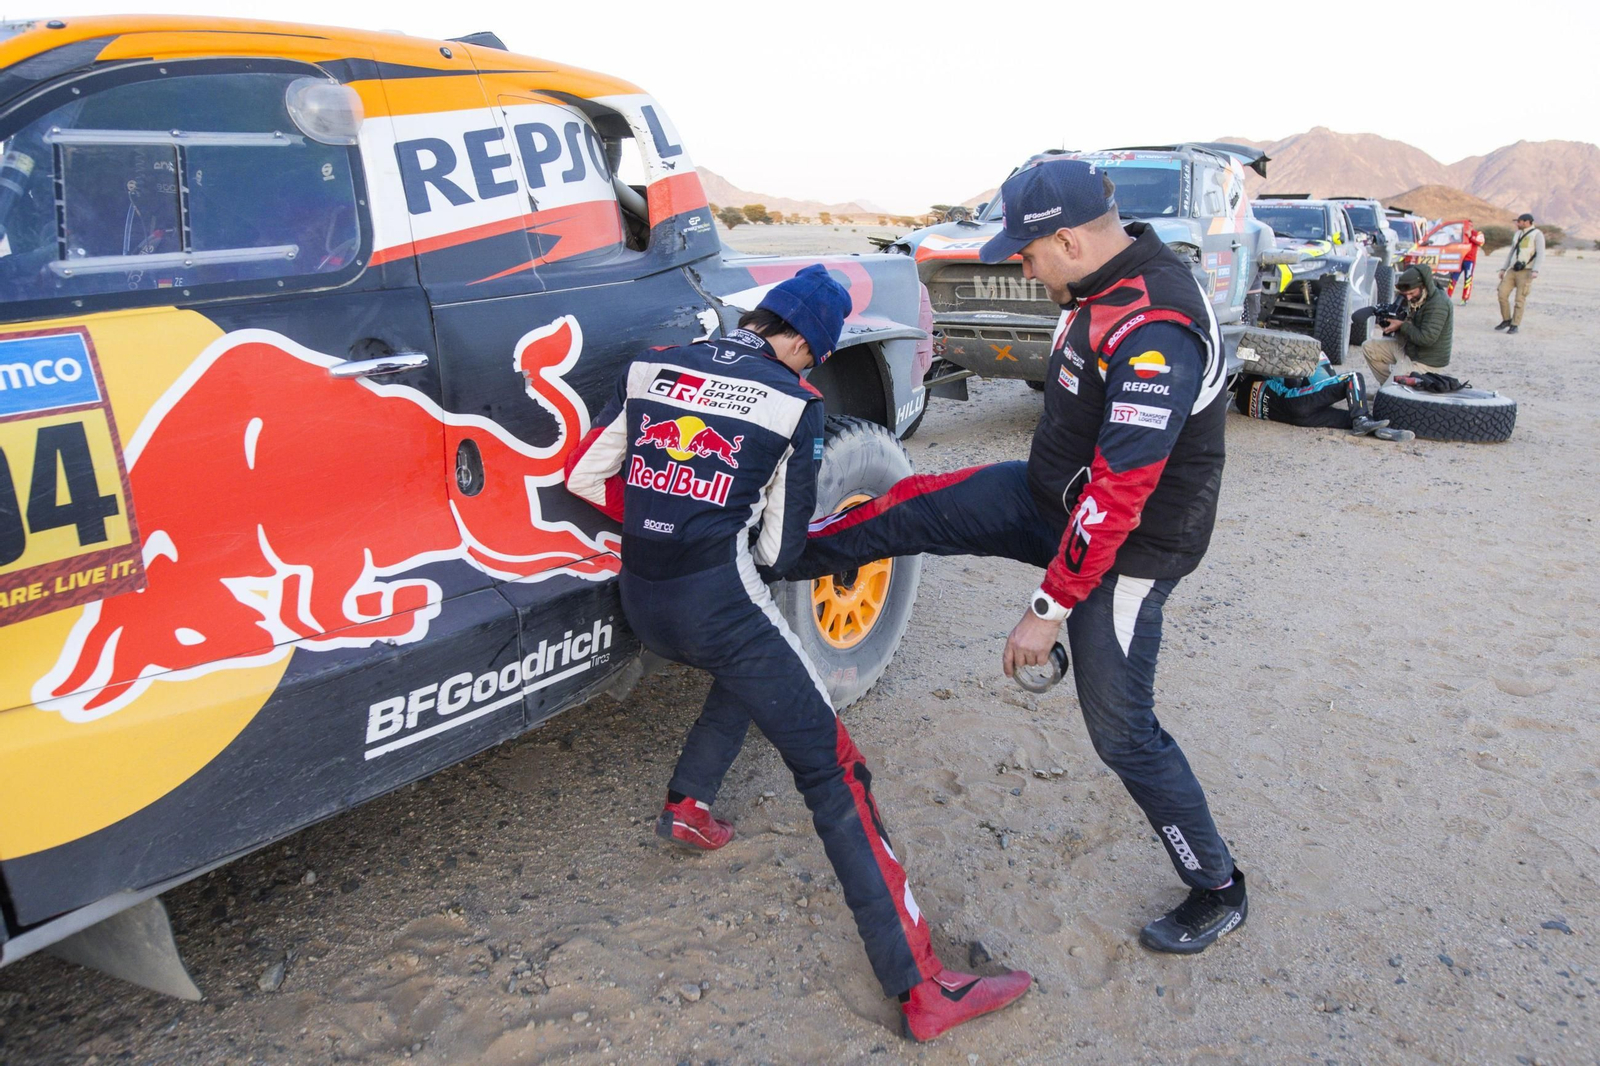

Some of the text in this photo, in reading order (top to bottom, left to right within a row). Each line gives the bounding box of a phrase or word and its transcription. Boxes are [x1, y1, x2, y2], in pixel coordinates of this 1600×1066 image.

[1023, 206, 1062, 221] BFGoodrich
[1421, 255, 1437, 266] 221
[973, 275, 1037, 302] MINI
[1107, 314, 1145, 348] sparco
[648, 378, 699, 403] GR
[702, 388, 758, 405] GAZOO
[708, 380, 768, 399] TOYOTA
[1122, 381, 1170, 396] REPSOL
[697, 397, 752, 415] Racing
[1113, 408, 1136, 422] TST
[1138, 417, 1162, 425] LOGISTICS
[1139, 411, 1168, 421] TRANSPORT
[670, 463, 735, 508] Bull
[644, 518, 675, 533] sparco
[1065, 495, 1108, 574] GR
[54, 566, 107, 593] LIVE
[110, 558, 137, 580] IT.
[365, 617, 614, 745] BFGoodrich
[1162, 825, 1202, 871] sparco
[1217, 912, 1242, 938] sparco
